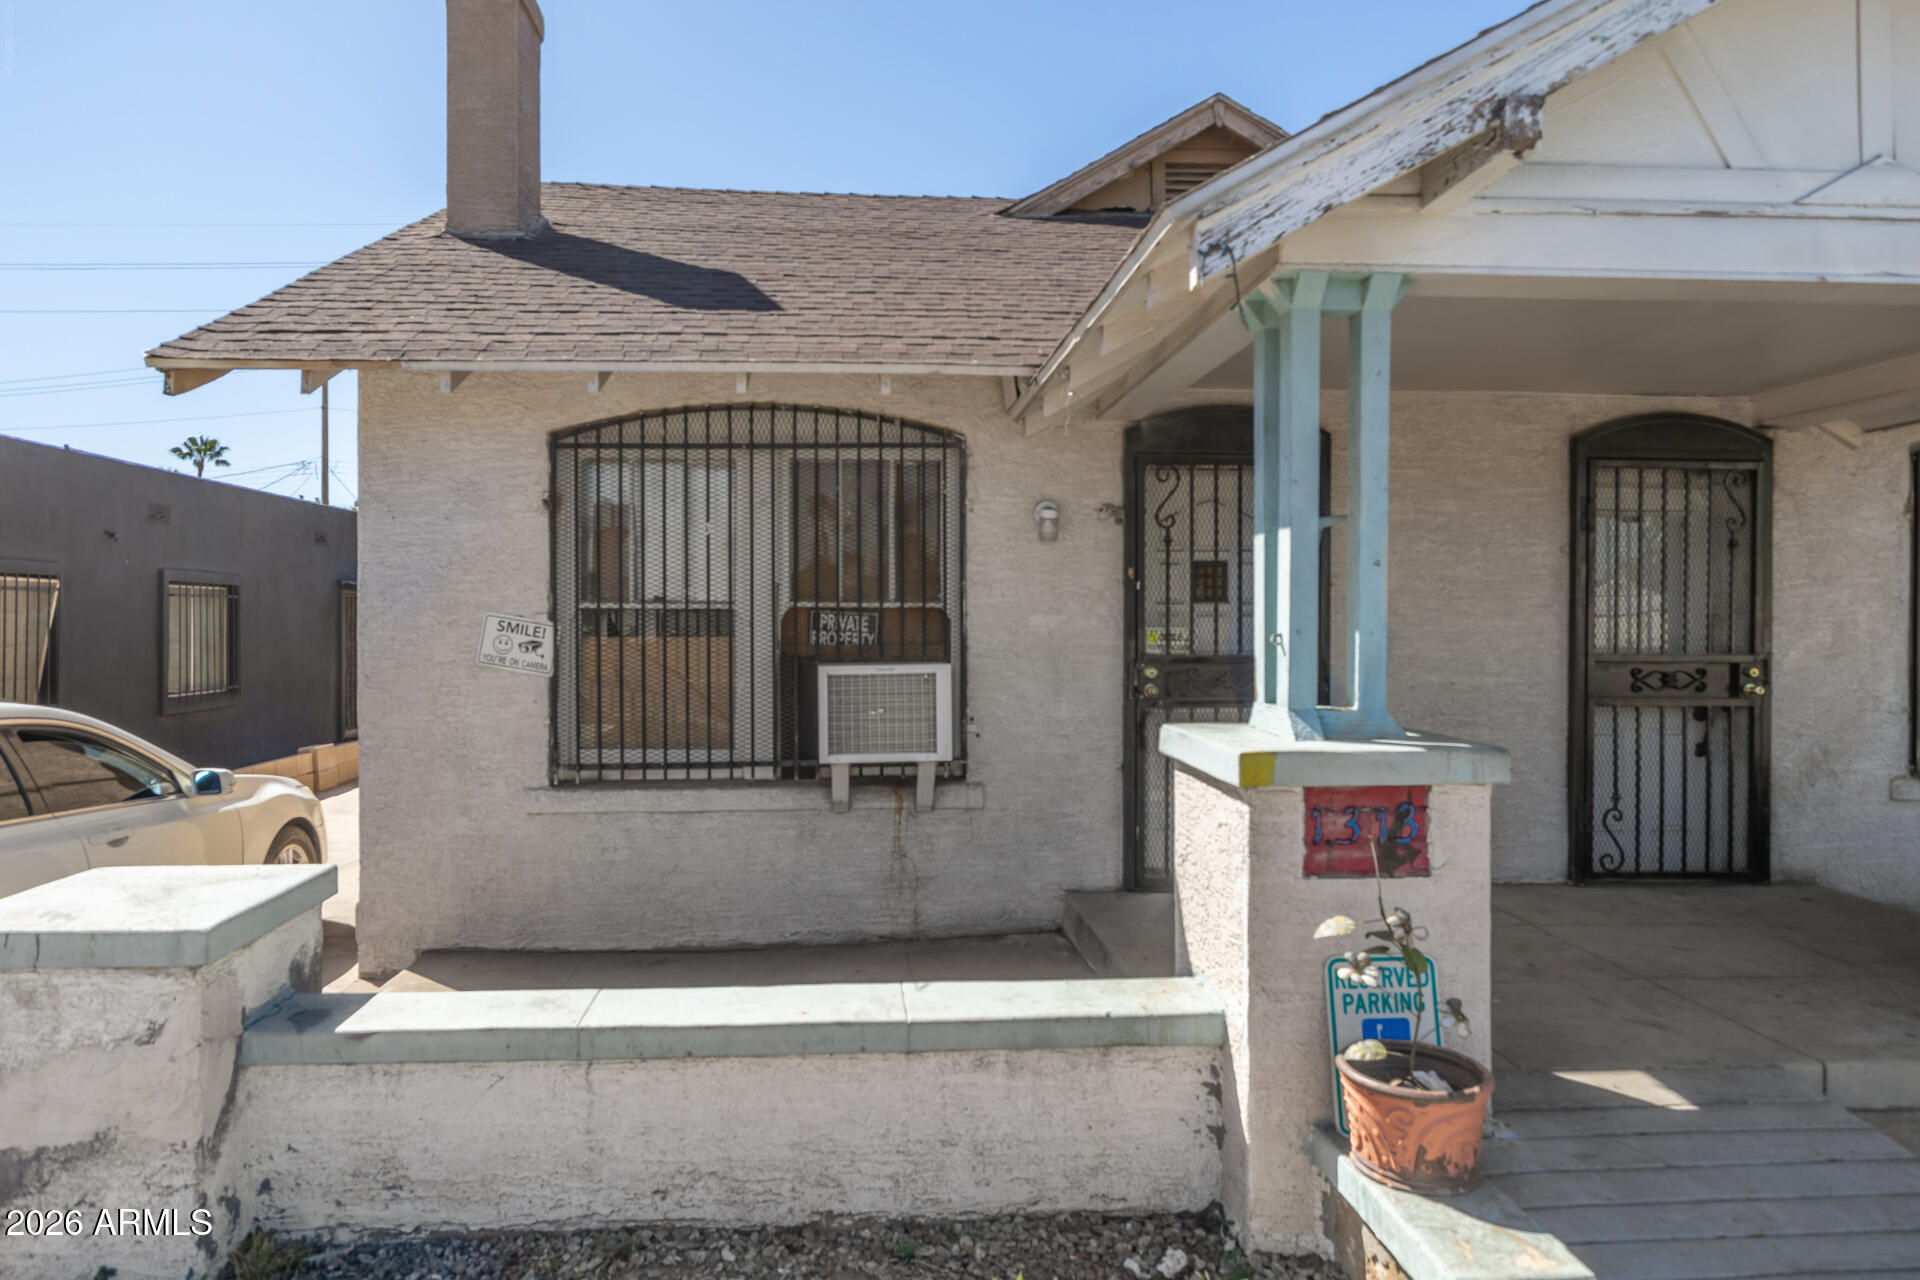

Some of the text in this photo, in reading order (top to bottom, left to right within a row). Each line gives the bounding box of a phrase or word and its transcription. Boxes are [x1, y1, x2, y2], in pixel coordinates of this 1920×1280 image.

[497, 620, 546, 639] SMILE!
[483, 654, 548, 671] YOU'RE ON CAMERA
[1343, 992, 1425, 1015] PARKING
